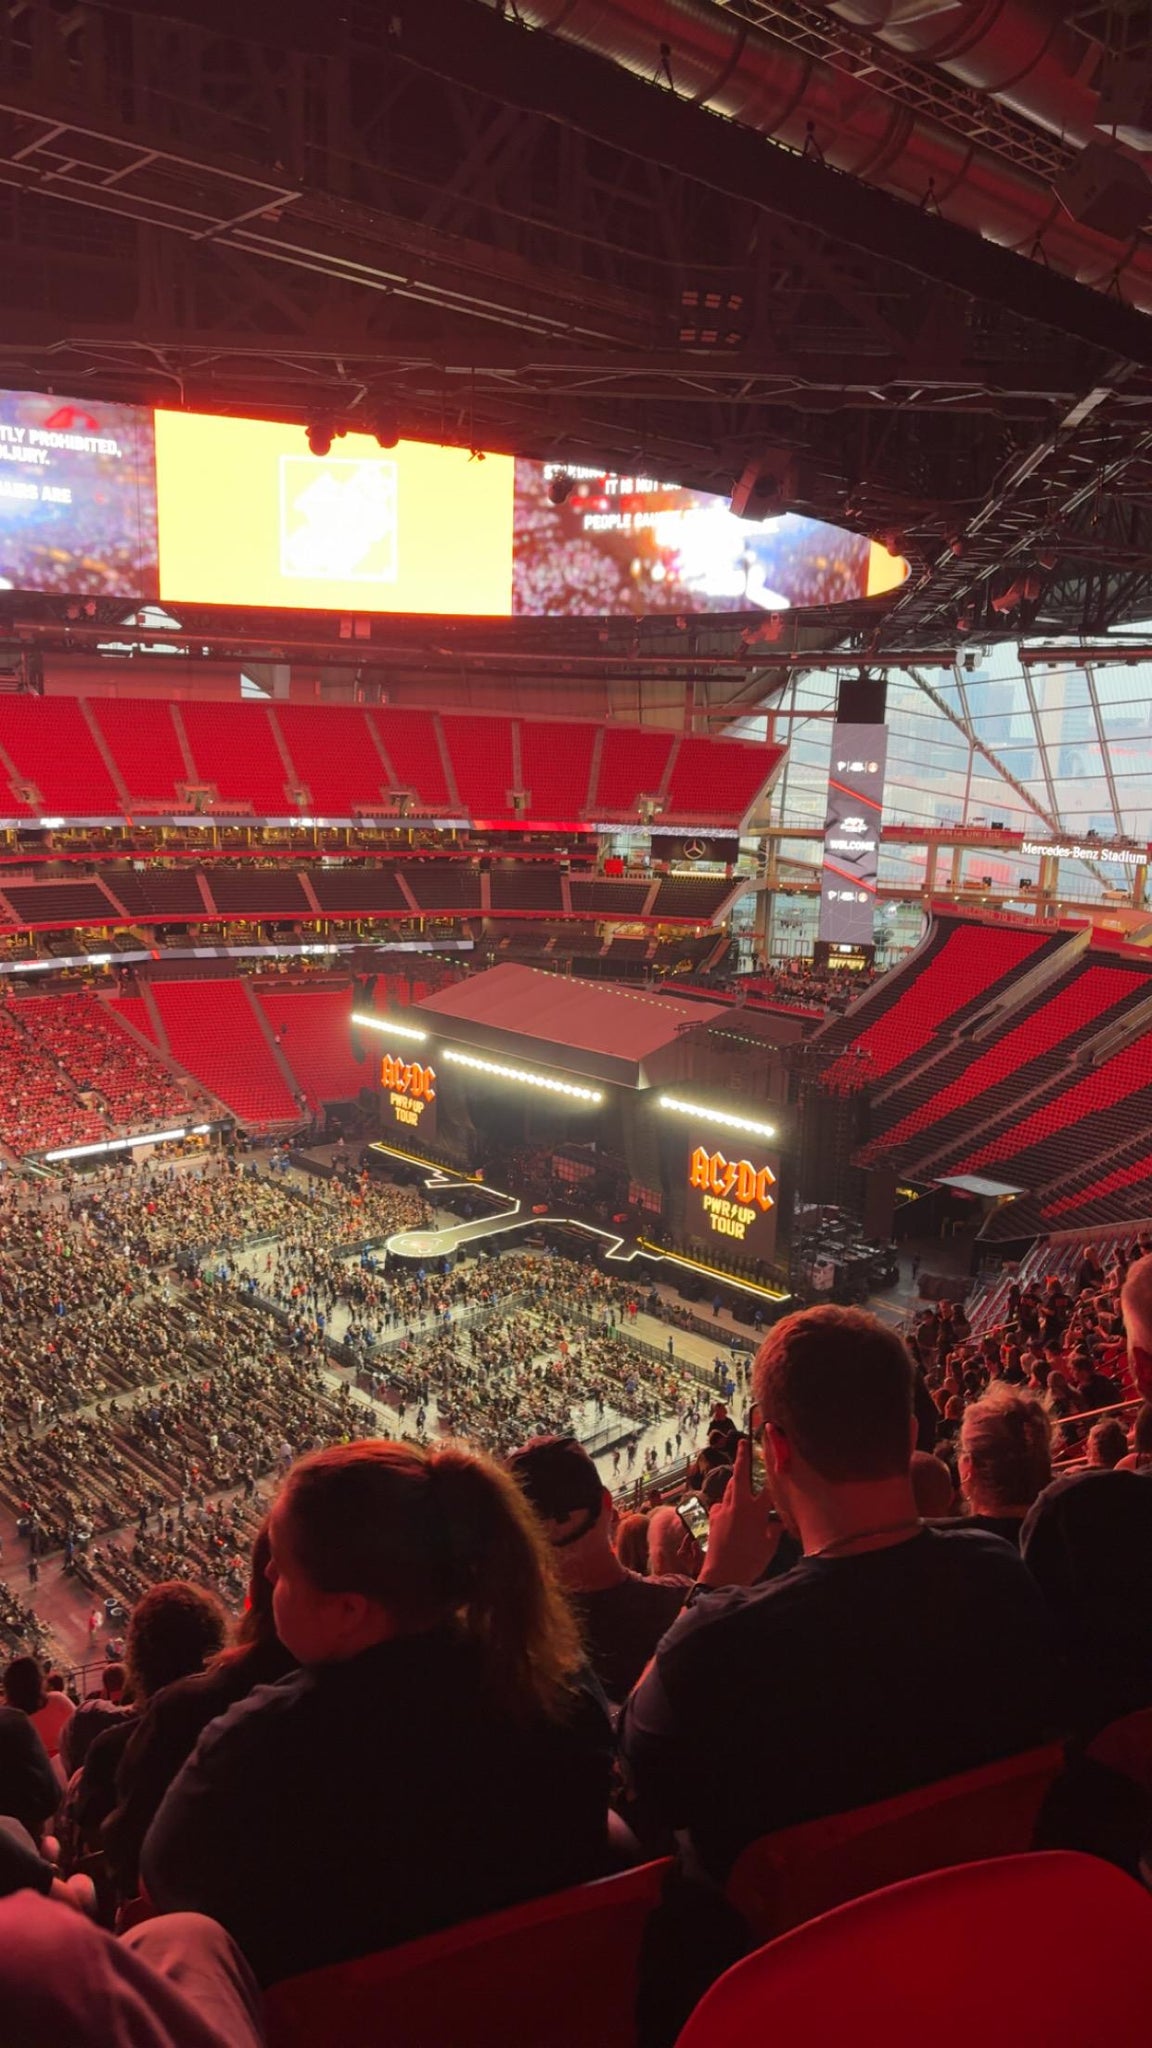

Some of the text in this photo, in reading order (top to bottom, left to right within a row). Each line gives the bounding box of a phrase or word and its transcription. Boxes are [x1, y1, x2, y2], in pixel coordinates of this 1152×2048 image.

[584, 514, 632, 530] PEOPLE
[829, 839, 876, 851] WELCOME
[1021, 842, 1147, 864] Mercedes-Benz Stadium
[395, 1106, 419, 1127] TOUR
[709, 1213, 746, 1240] TOUR
